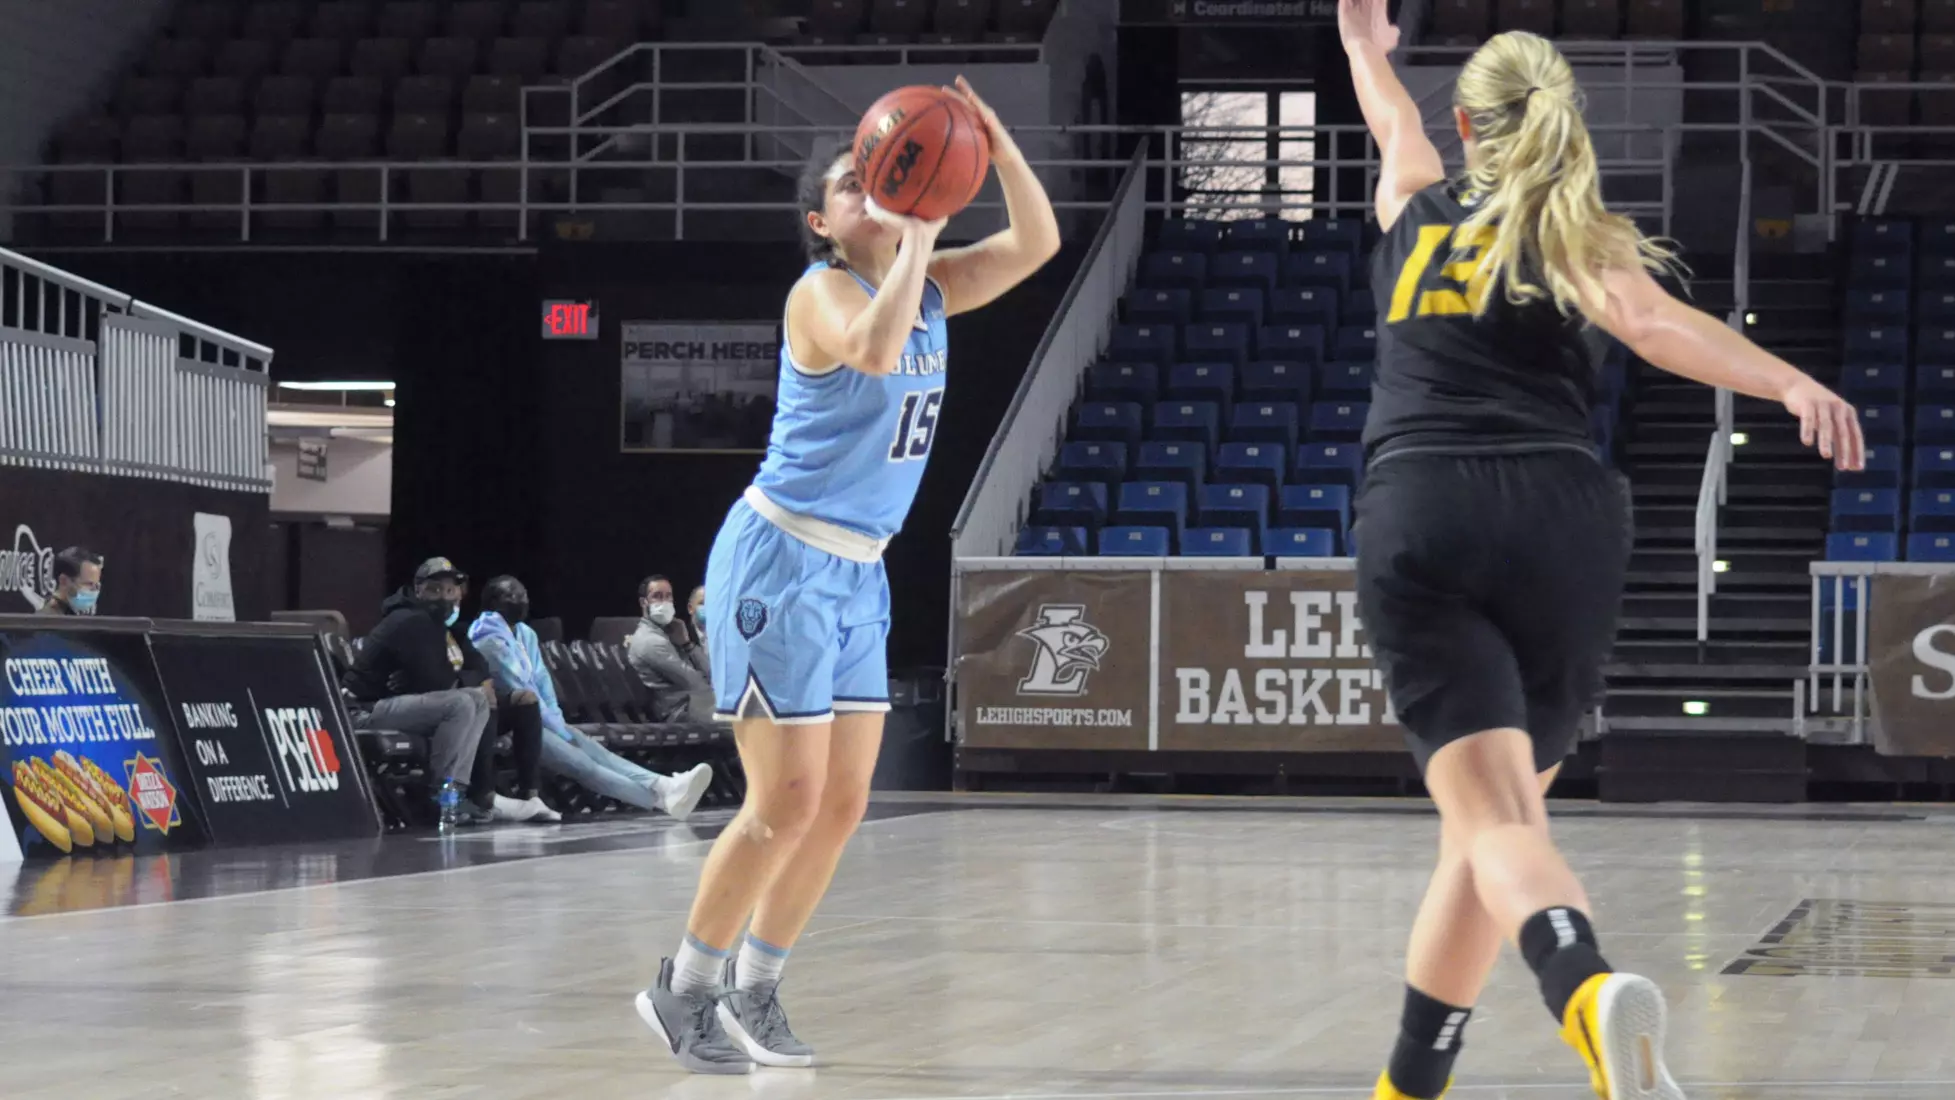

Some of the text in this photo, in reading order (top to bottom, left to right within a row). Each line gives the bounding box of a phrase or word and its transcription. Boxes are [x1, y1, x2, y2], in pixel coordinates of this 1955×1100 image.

[1193, 0, 1304, 16] Coordinated
[551, 303, 590, 334] EXIT
[624, 341, 777, 360] PERCH HERE
[888, 386, 946, 462] 15
[5, 657, 117, 696] CHEER WITH
[40, 705, 110, 744] MOUTH
[103, 703, 156, 741] FULL.
[182, 702, 238, 728] BANKING
[975, 706, 1133, 727] LEHIGHSPORTS.COM
[195, 739, 230, 766] ON A
[264, 707, 339, 792] PSECU
[207, 774, 275, 803] DIFFERENCE.
